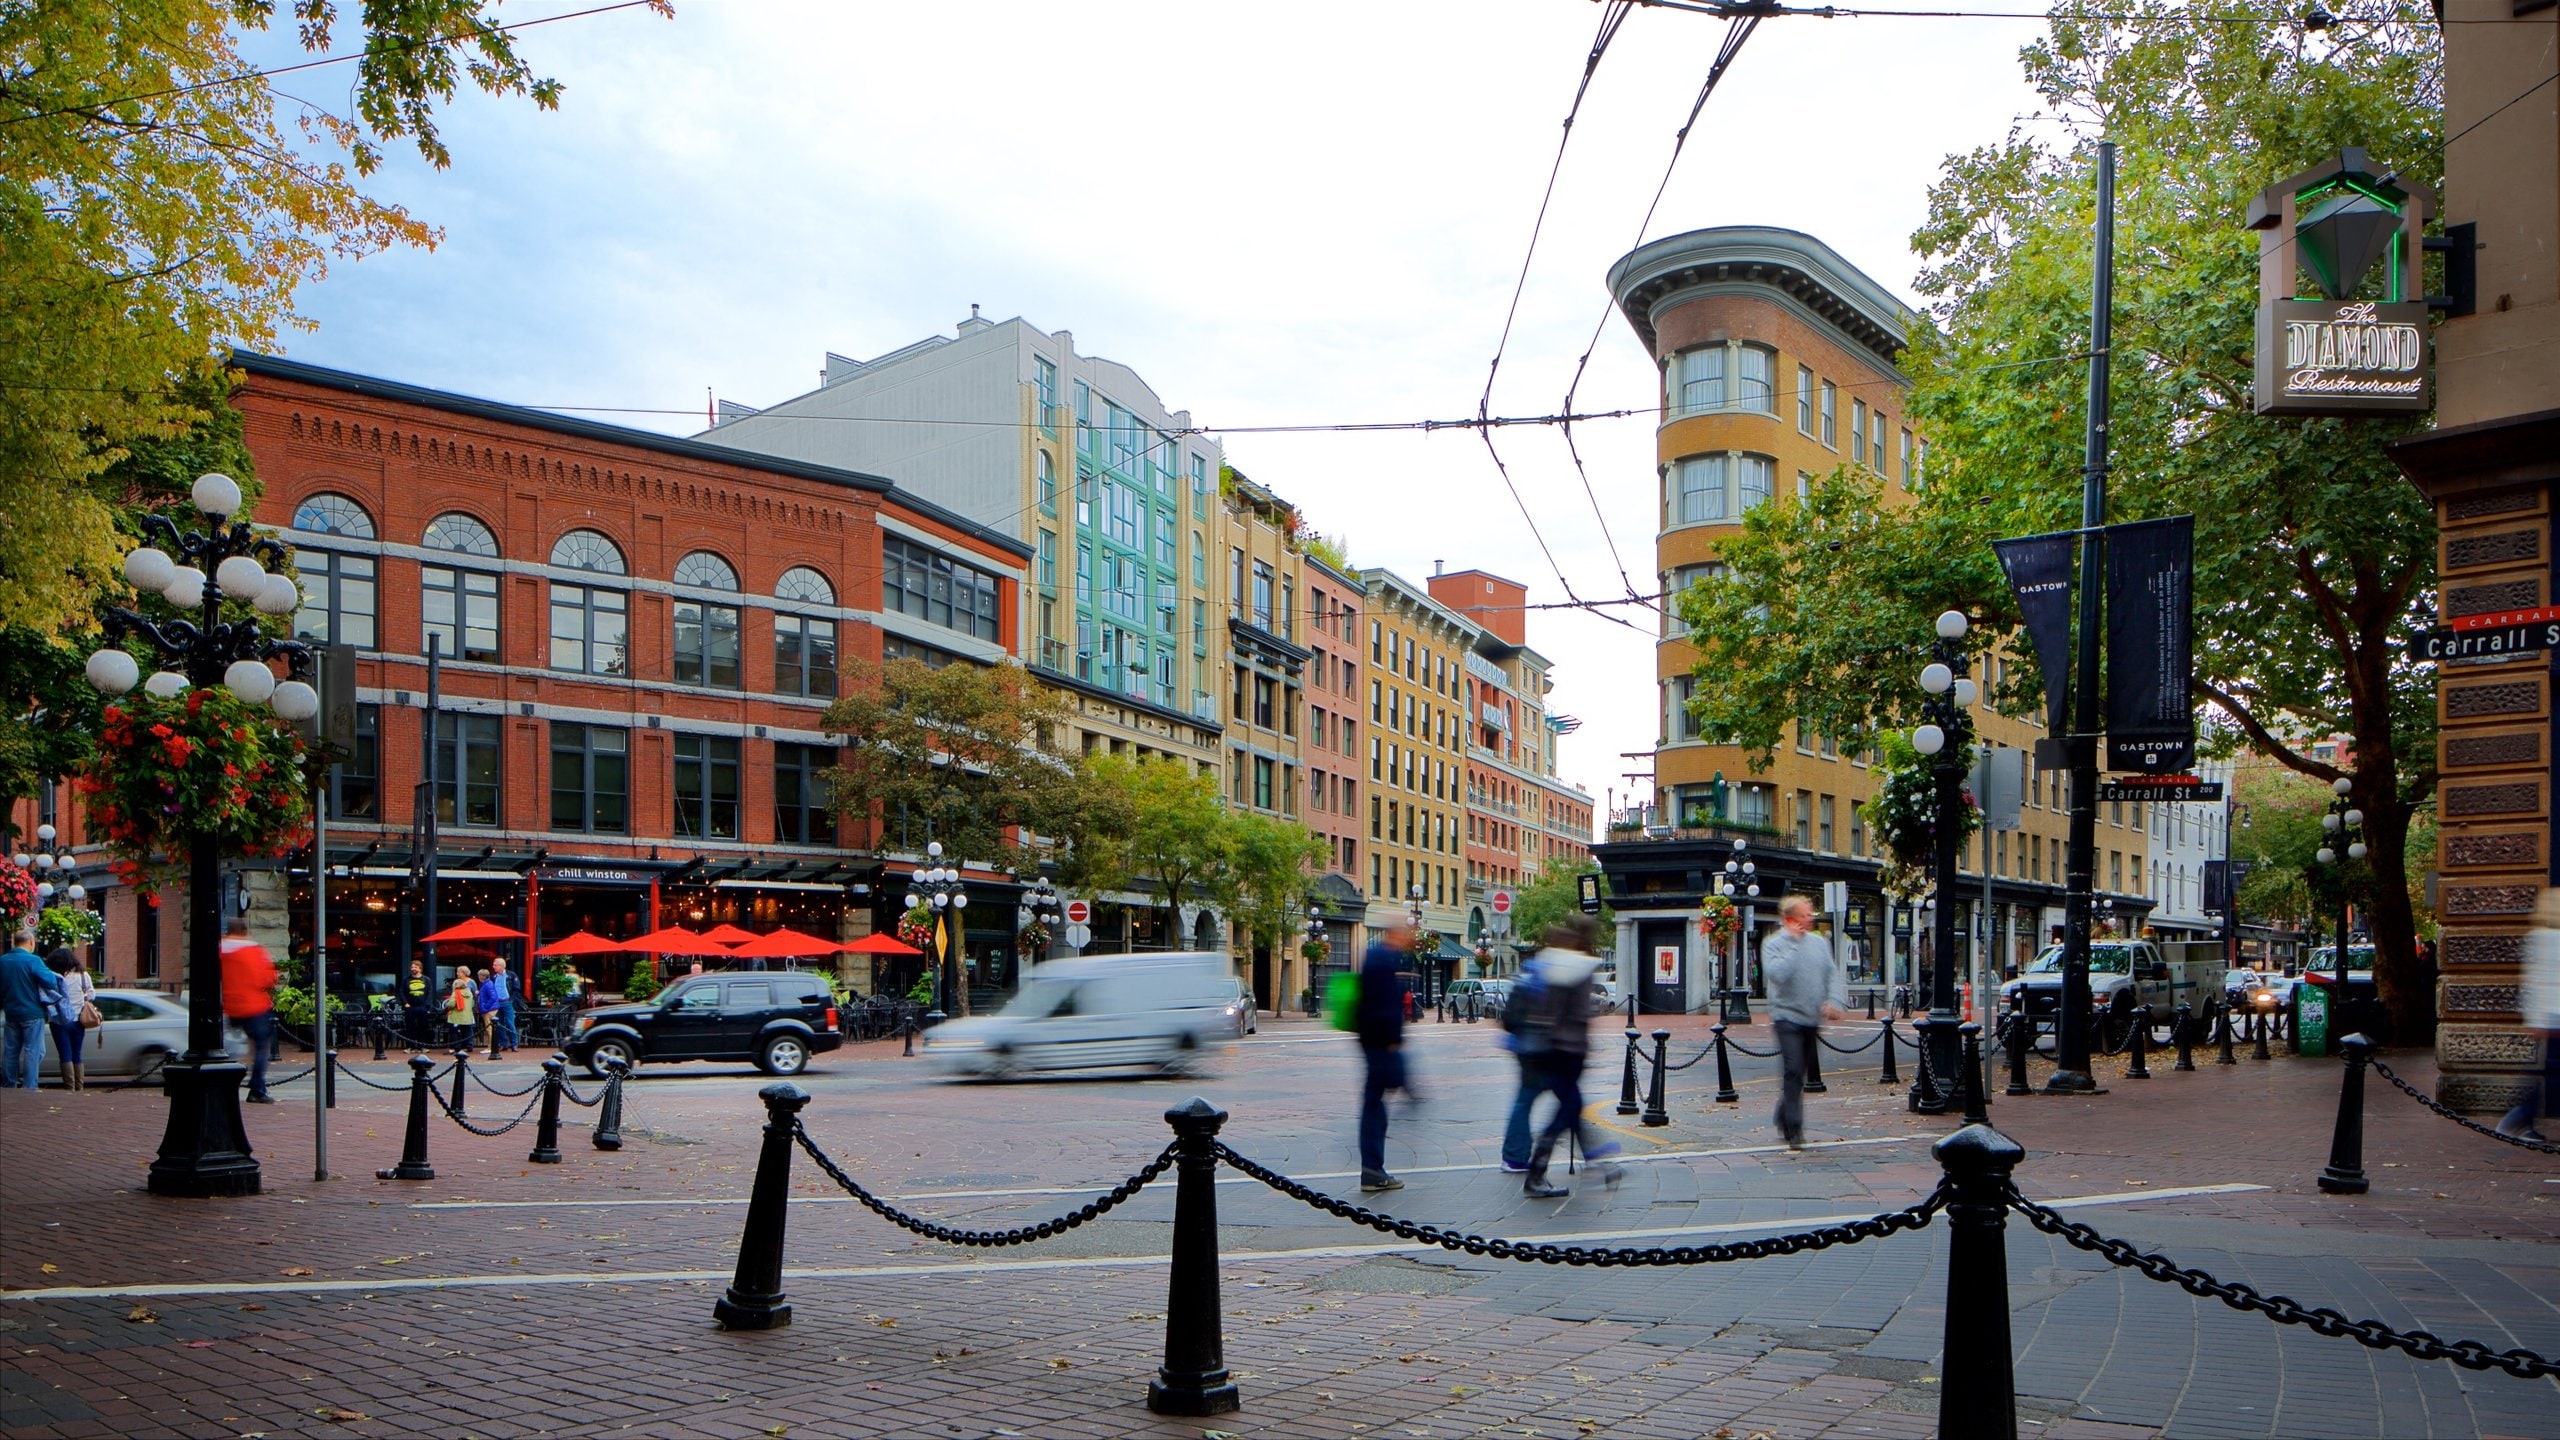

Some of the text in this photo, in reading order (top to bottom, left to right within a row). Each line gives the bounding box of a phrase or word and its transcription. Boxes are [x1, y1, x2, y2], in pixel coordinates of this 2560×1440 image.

[2336, 302, 2377, 324] The
[2286, 323, 2420, 371] DIAMOND
[2284, 369, 2422, 393] Restaurant
[2427, 628, 2526, 658] Carrall
[2120, 741, 2183, 752] GASTOWN
[2132, 776, 2188, 784] CARRALL
[2107, 786, 2214, 800] Carrall St 200
[558, 868, 628, 880] chill winston
